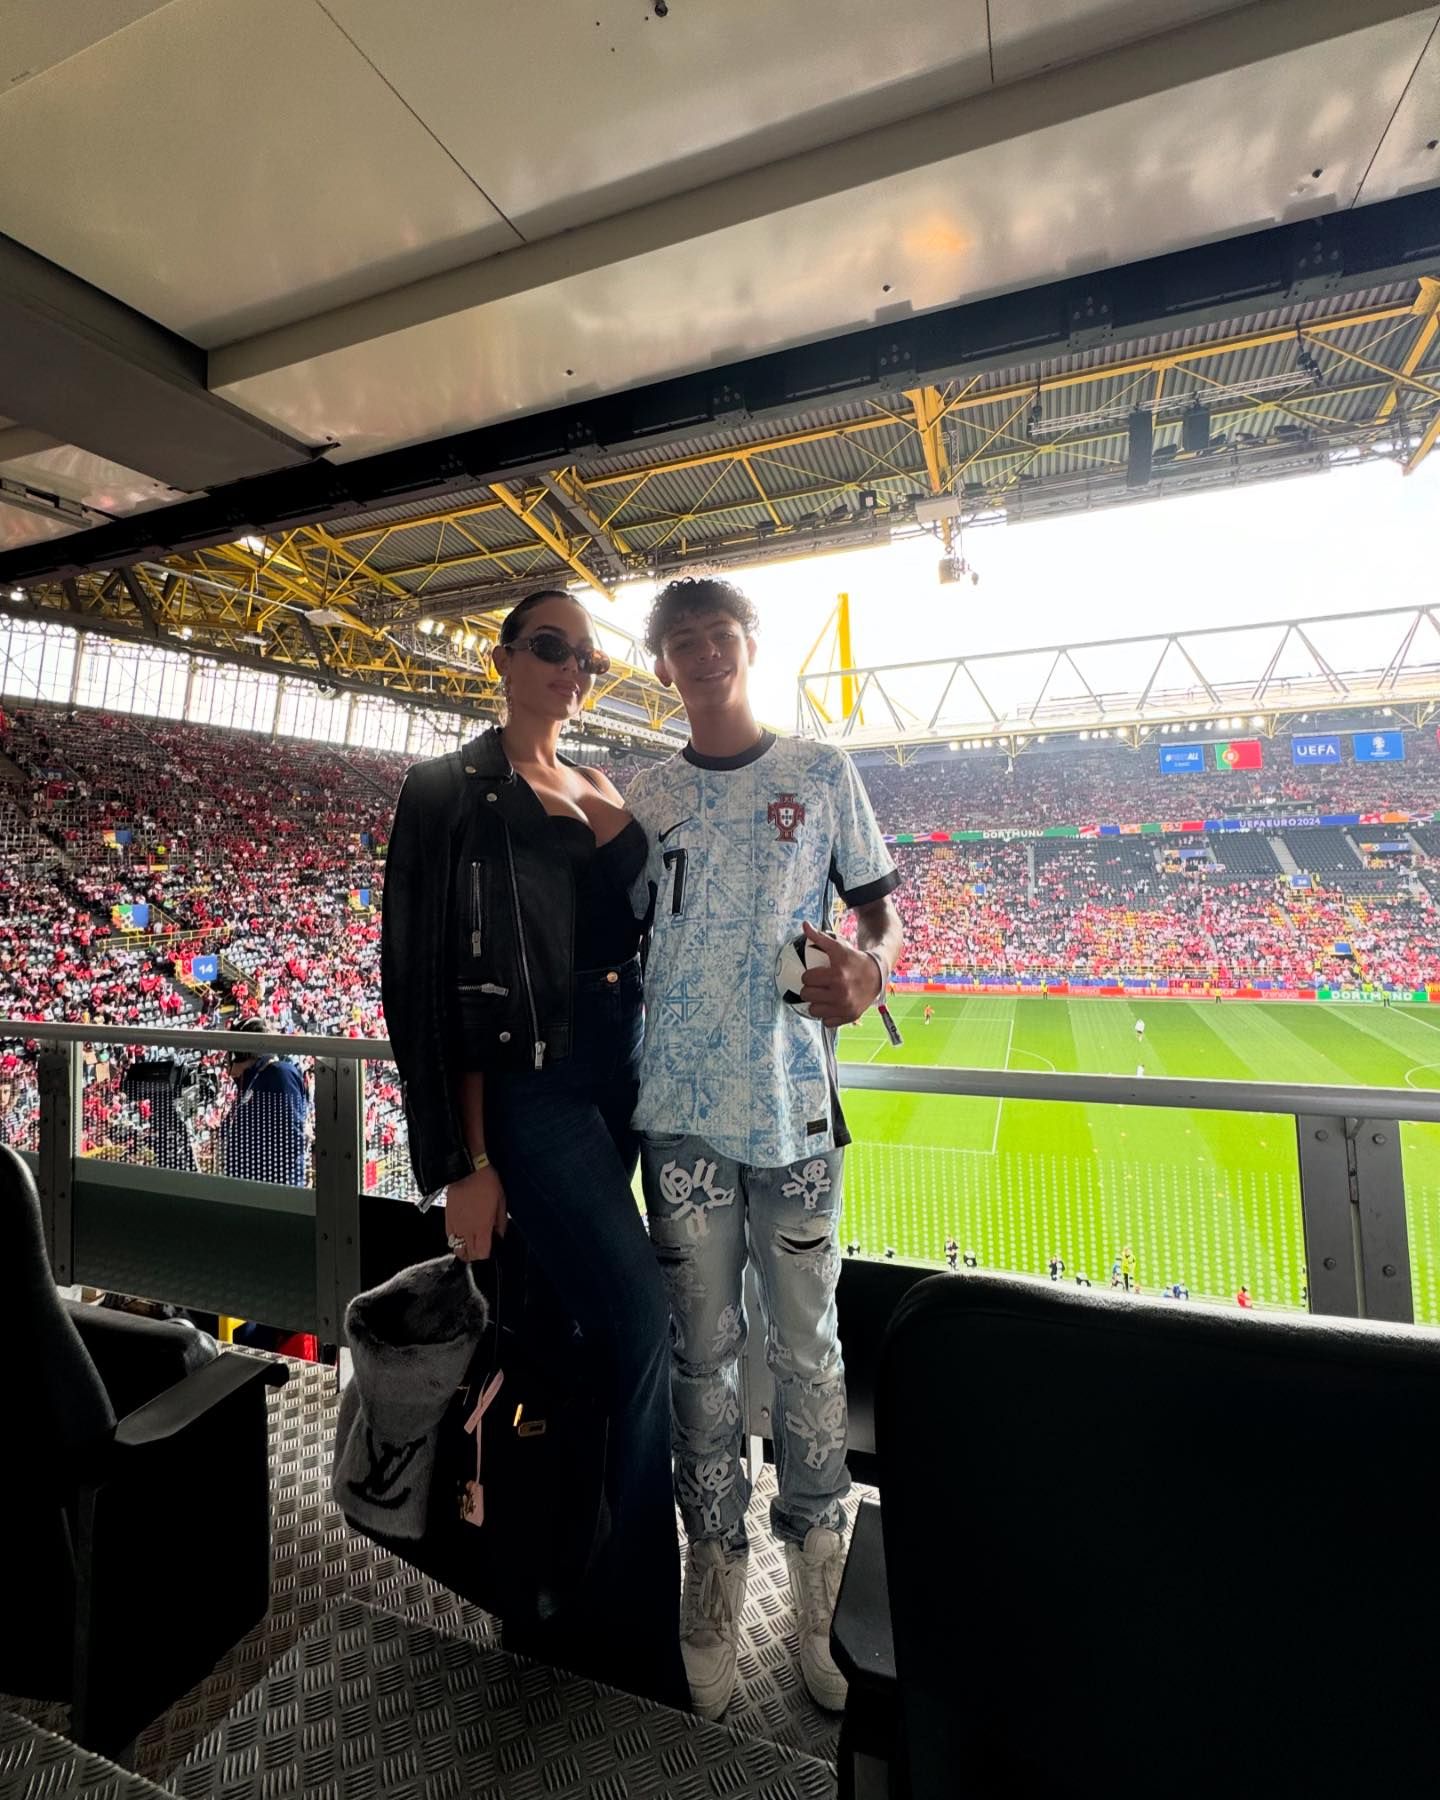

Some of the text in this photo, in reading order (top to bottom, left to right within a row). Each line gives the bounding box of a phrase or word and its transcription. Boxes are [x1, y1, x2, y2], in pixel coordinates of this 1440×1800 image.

[1296, 744, 1336, 756] UEFA
[982, 828, 1044, 839] DORTMUND
[662, 848, 688, 916] 7
[198, 963, 214, 975] 14
[1331, 991, 1413, 1000] DORTMND
